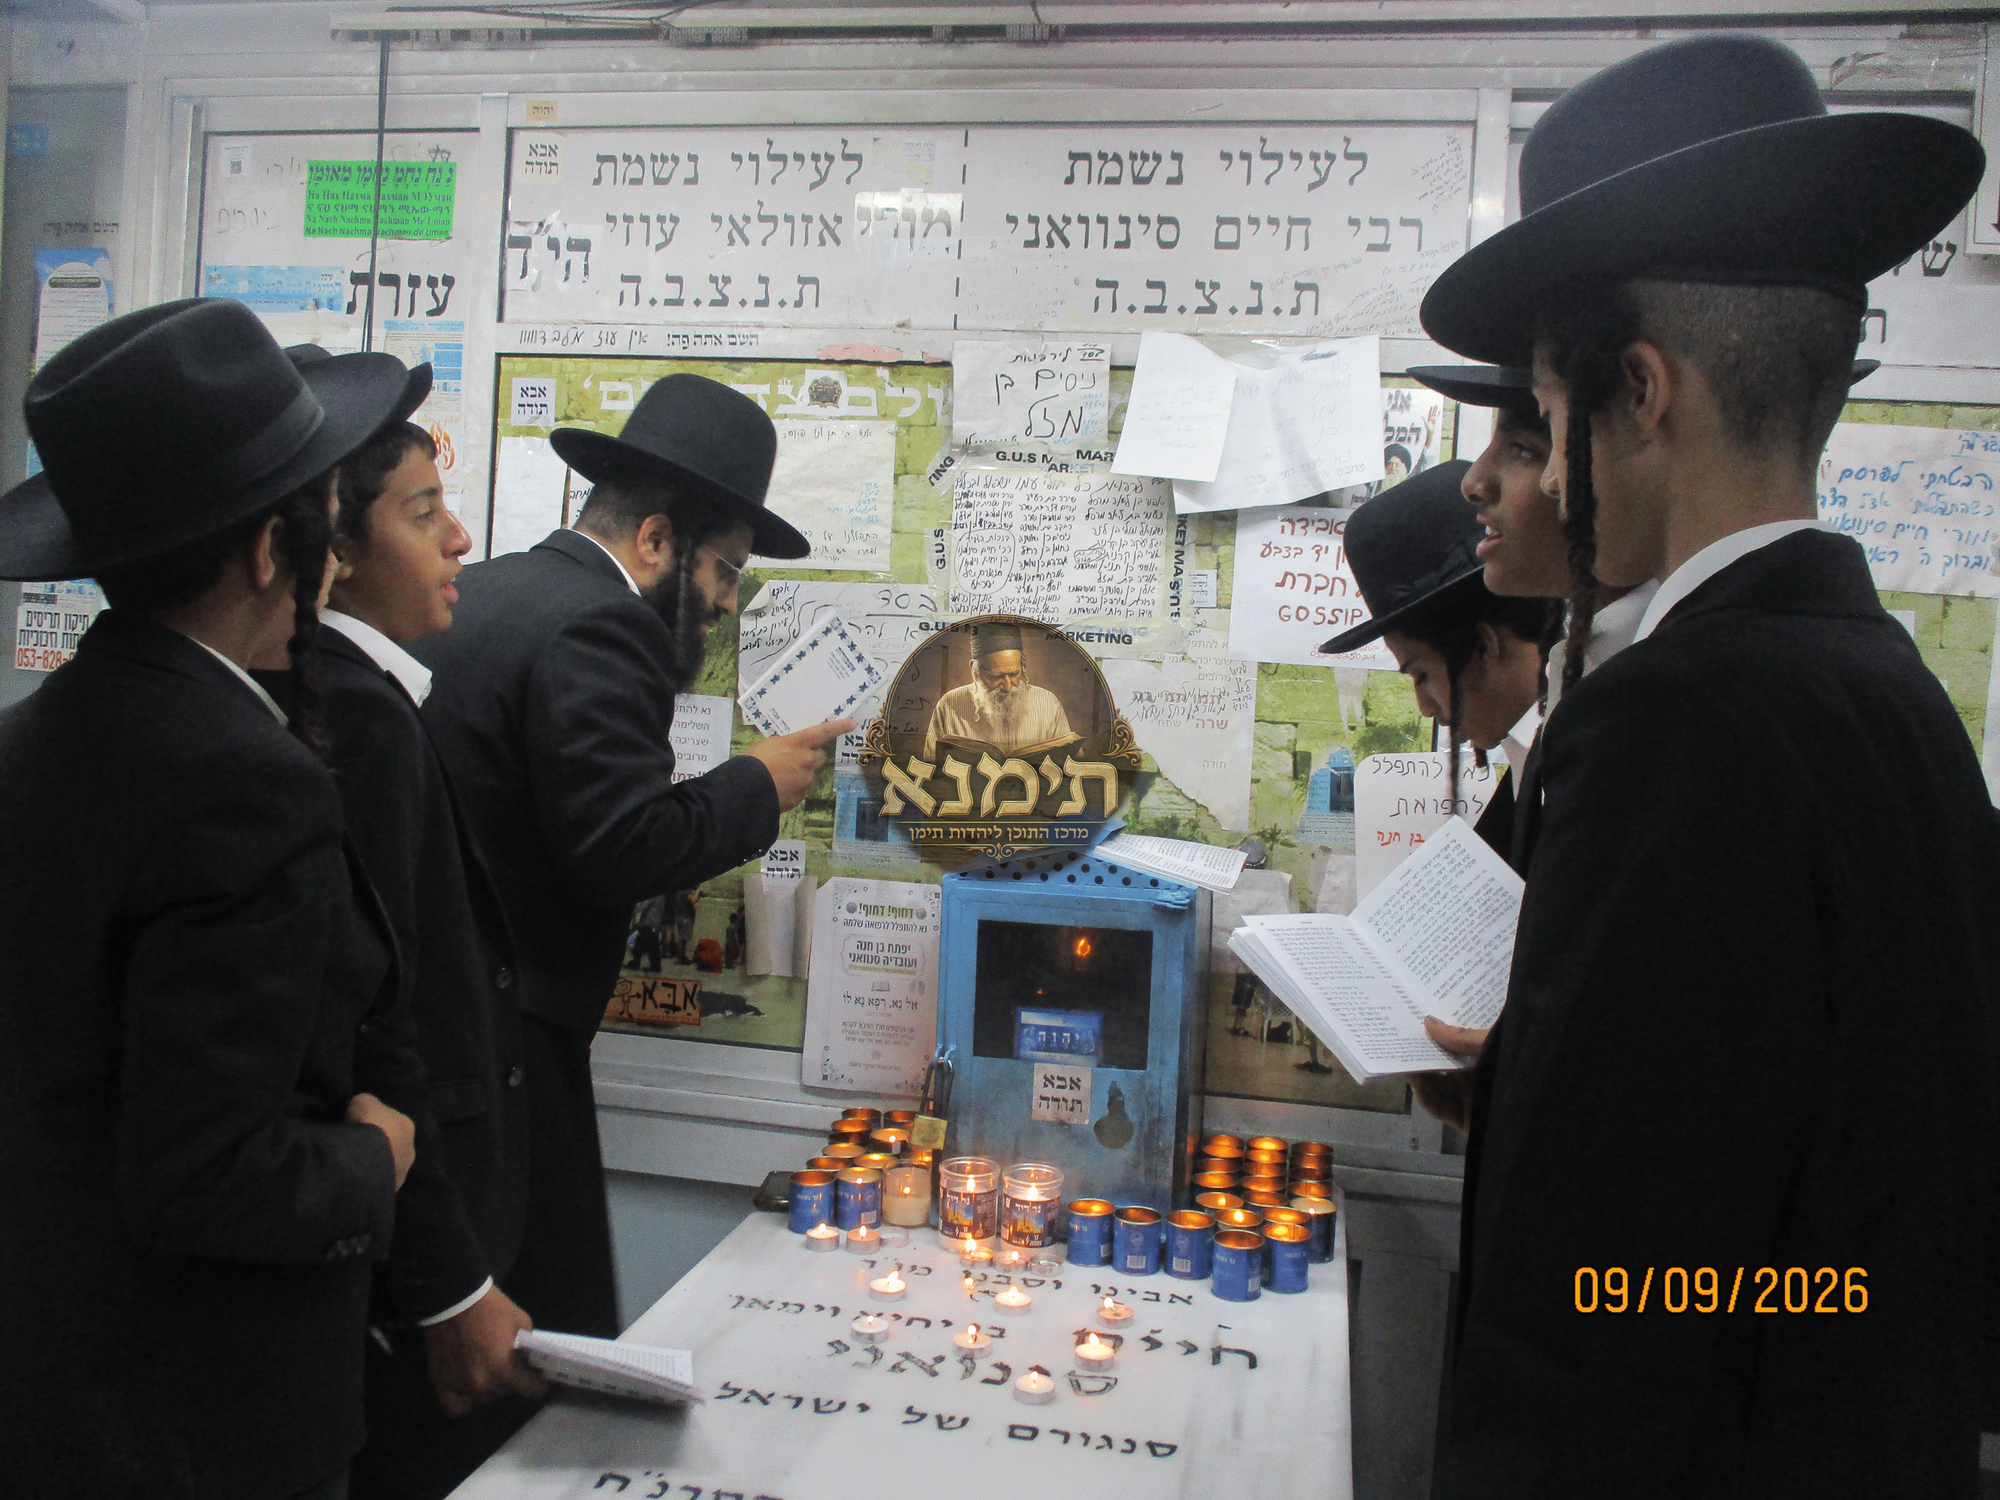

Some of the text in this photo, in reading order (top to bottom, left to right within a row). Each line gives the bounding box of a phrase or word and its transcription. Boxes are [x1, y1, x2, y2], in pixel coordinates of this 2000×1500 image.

[528, 143, 558, 157] אבא
[525, 160, 559, 175] תודה
[592, 152, 700, 187] נשמת
[730, 138, 864, 192] לעילוי
[1063, 149, 1185, 186] נשמת
[1219, 135, 1368, 194] לעילוי
[379, 215, 410, 225] achman
[710, 200, 843, 248] אזולאי
[605, 211, 681, 253] עוזי
[1005, 213, 1423, 252] רבי חיים סינוואני
[346, 269, 456, 318] עזרת
[619, 273, 821, 309] ת.נ.צ.ב.ה
[1092, 277, 1320, 318] ת.נ.צ.ב.ה
[693, 333, 723, 346] אתה
[727, 333, 759, 346] השם
[520, 385, 547, 398] אבא
[995, 368, 1096, 405] ניסים בן
[517, 403, 549, 415] תודה
[1025, 393, 1084, 439] מזל
[996, 450, 1037, 464] G.U.S
[1260, 541, 1303, 559] בצבע
[1275, 571, 1347, 597] חברת
[1278, 604, 1363, 626] GOSSIP
[1372, 756, 1443, 779] להתפלל
[1377, 831, 1426, 846] בן חנה
[769, 849, 799, 861] אבא
[858, 903, 914, 919] דחוף! דחוף!
[891, 921, 918, 933] להתפלל
[856, 940, 911, 954] יפתח בן חנה
[883, 956, 917, 968] ועובדיה
[641, 980, 697, 1016] אבא
[906, 996, 919, 1010] אל
[1038, 1031, 1080, 1044] יהוה
[1043, 1073, 1082, 1091] אבא
[1039, 1094, 1083, 1112] תודה
[714, 1381, 1178, 1458] סנגורם של ישראל
